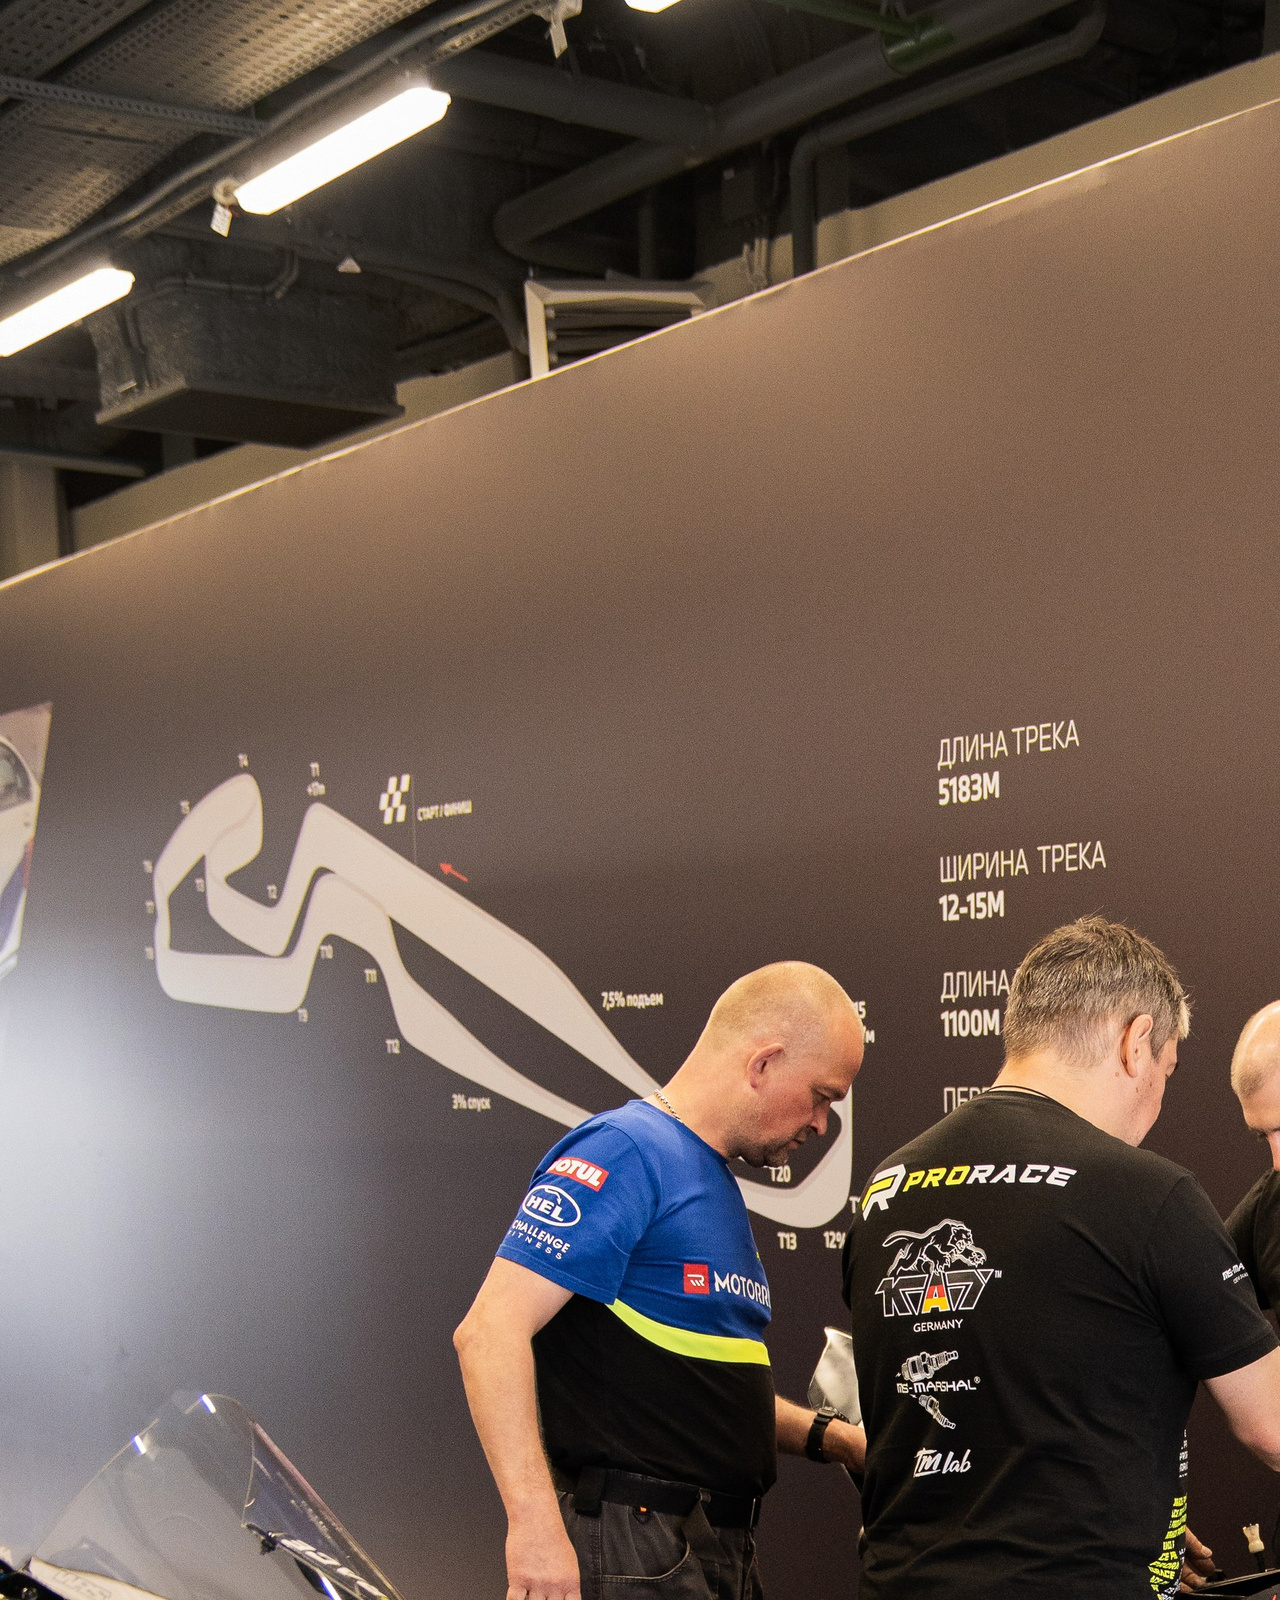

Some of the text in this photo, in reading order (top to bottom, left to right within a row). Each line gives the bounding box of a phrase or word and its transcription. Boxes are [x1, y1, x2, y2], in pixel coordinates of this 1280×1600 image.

[937, 719, 1080, 771] ДЛИНА ТРЕКА
[938, 771, 1000, 806] 5183М
[940, 841, 1107, 883] ШИРИНА ТРЕКА
[938, 890, 1005, 921] 12-15М
[626, 992, 664, 1009] подъем
[941, 969, 1010, 1003] ДЛИНА
[940, 1009, 1000, 1038] 1100М
[769, 1165, 791, 1183] T20
[902, 1164, 1078, 1193] PRORACE
[526, 1195, 564, 1222] HEL
[508, 1230, 563, 1260] FITNESS
[511, 1219, 571, 1254] CHALLENGE
[777, 1231, 797, 1251] T13
[913, 1318, 964, 1333] GERMANY
[942, 1449, 971, 1474] lab
